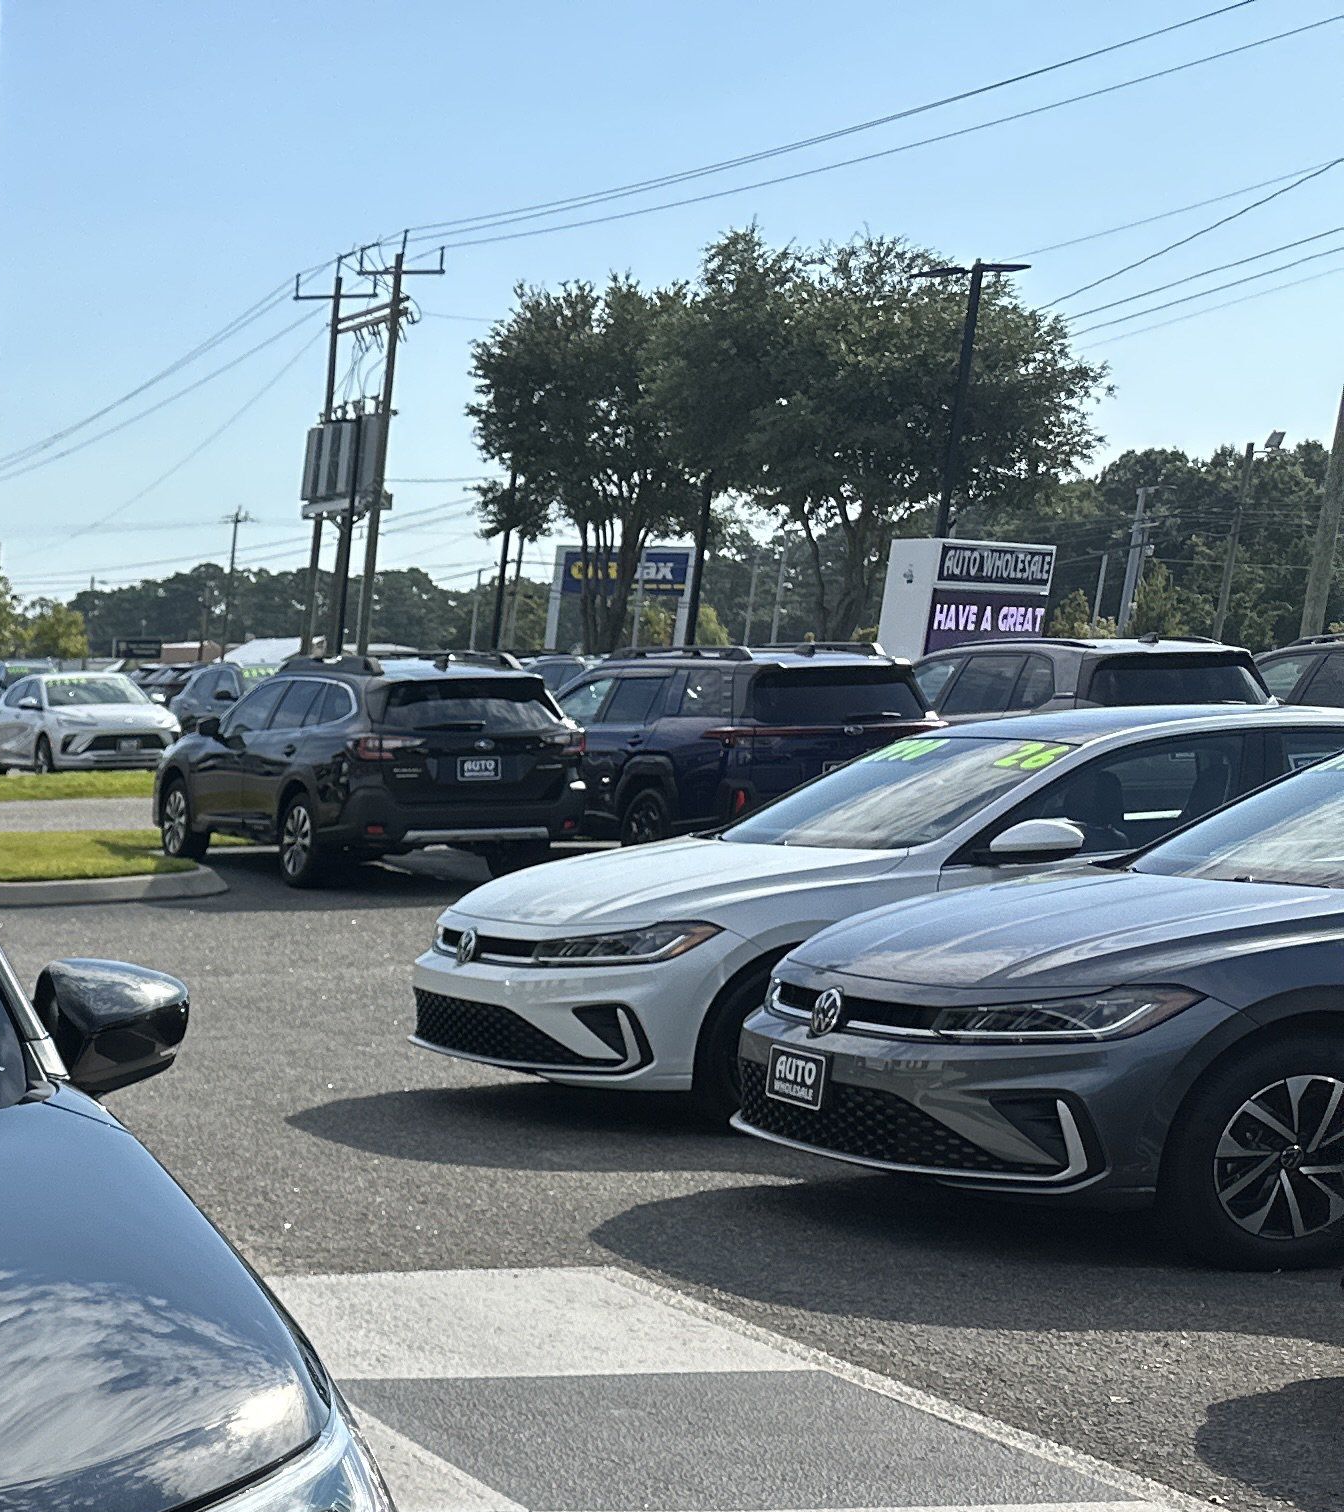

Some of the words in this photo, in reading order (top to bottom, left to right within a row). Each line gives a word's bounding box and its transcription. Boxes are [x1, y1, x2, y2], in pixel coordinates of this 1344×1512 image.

[943, 549, 980, 577] AUTO
[982, 551, 1051, 580] WHOLESALE
[933, 603, 978, 631] HAVE
[980, 605, 992, 631] A
[998, 606, 1045, 632] GREAT
[463, 760, 496, 771] AUTO
[993, 742, 1070, 769] 26
[776, 1055, 816, 1085] AUTO
[774, 1079, 813, 1100] WHOLESALE
